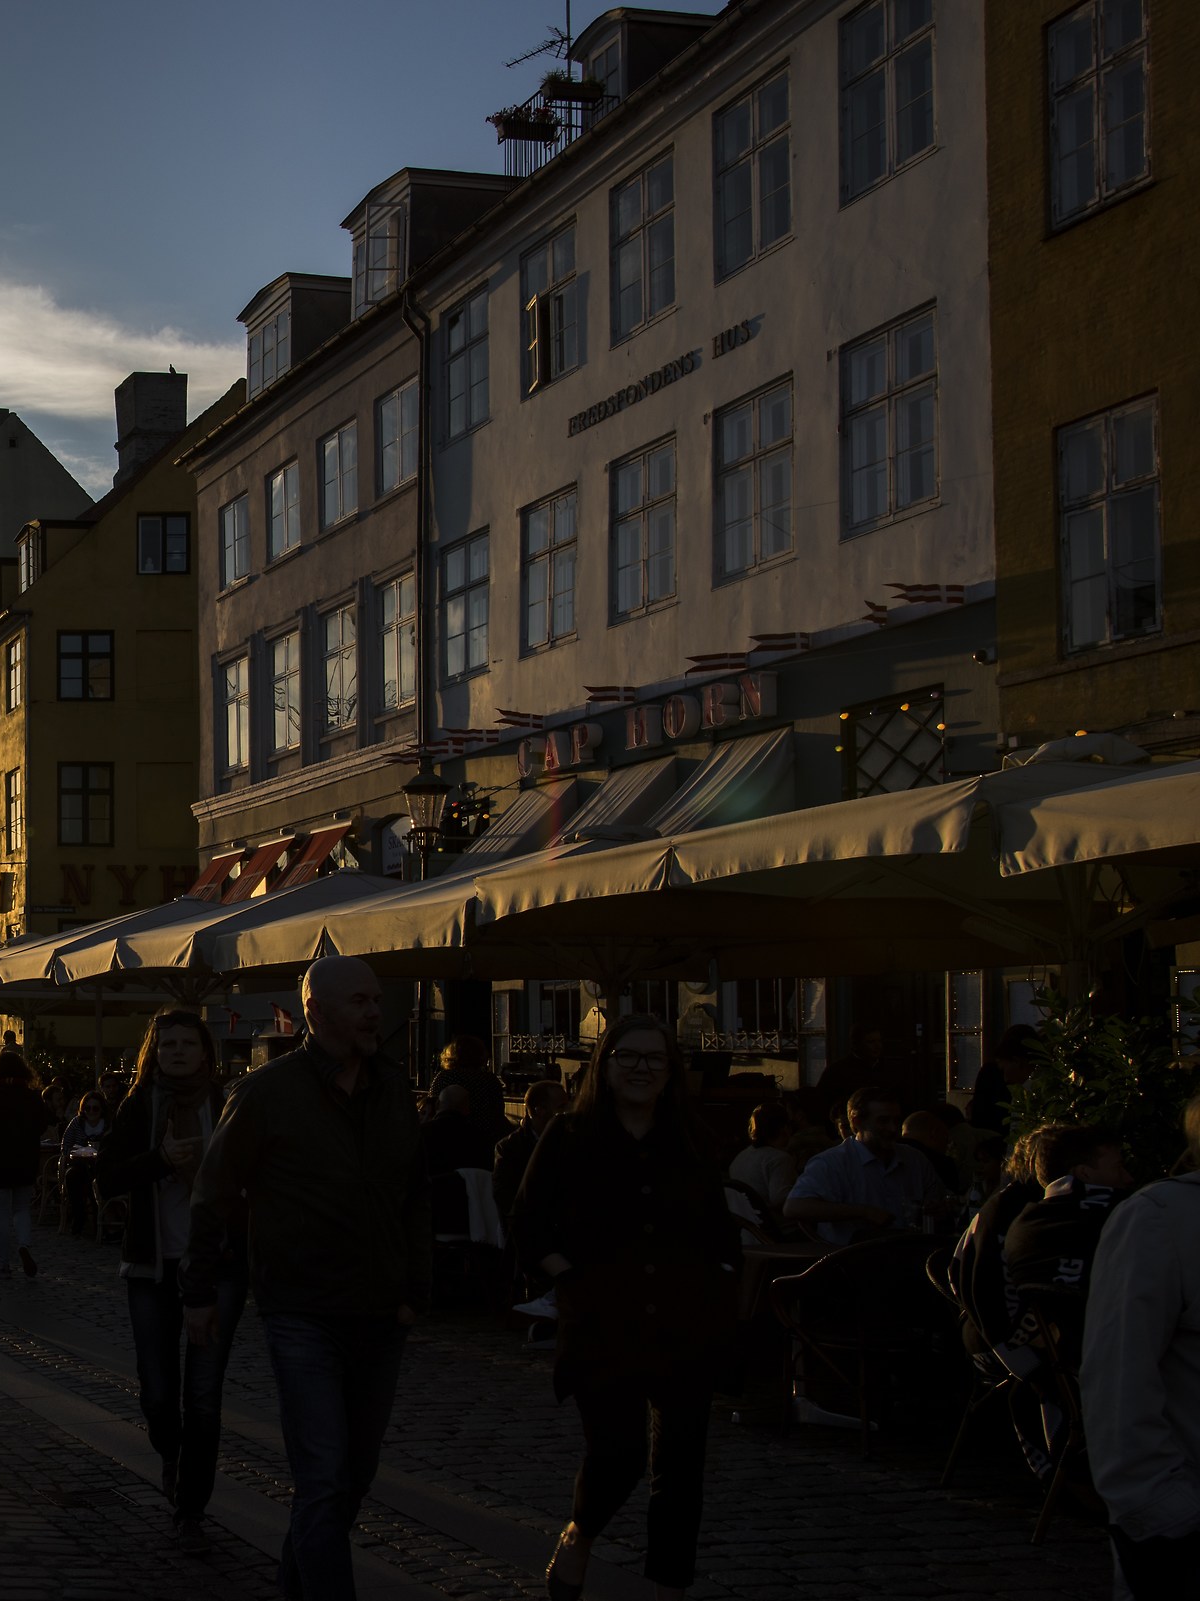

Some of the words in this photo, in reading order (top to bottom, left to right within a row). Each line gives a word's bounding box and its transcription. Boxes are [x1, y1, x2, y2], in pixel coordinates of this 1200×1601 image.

[567, 351, 697, 438] FREDSFONDENS
[711, 319, 751, 360] HUS
[517, 722, 597, 778] CAP
[624, 671, 768, 750] HORN
